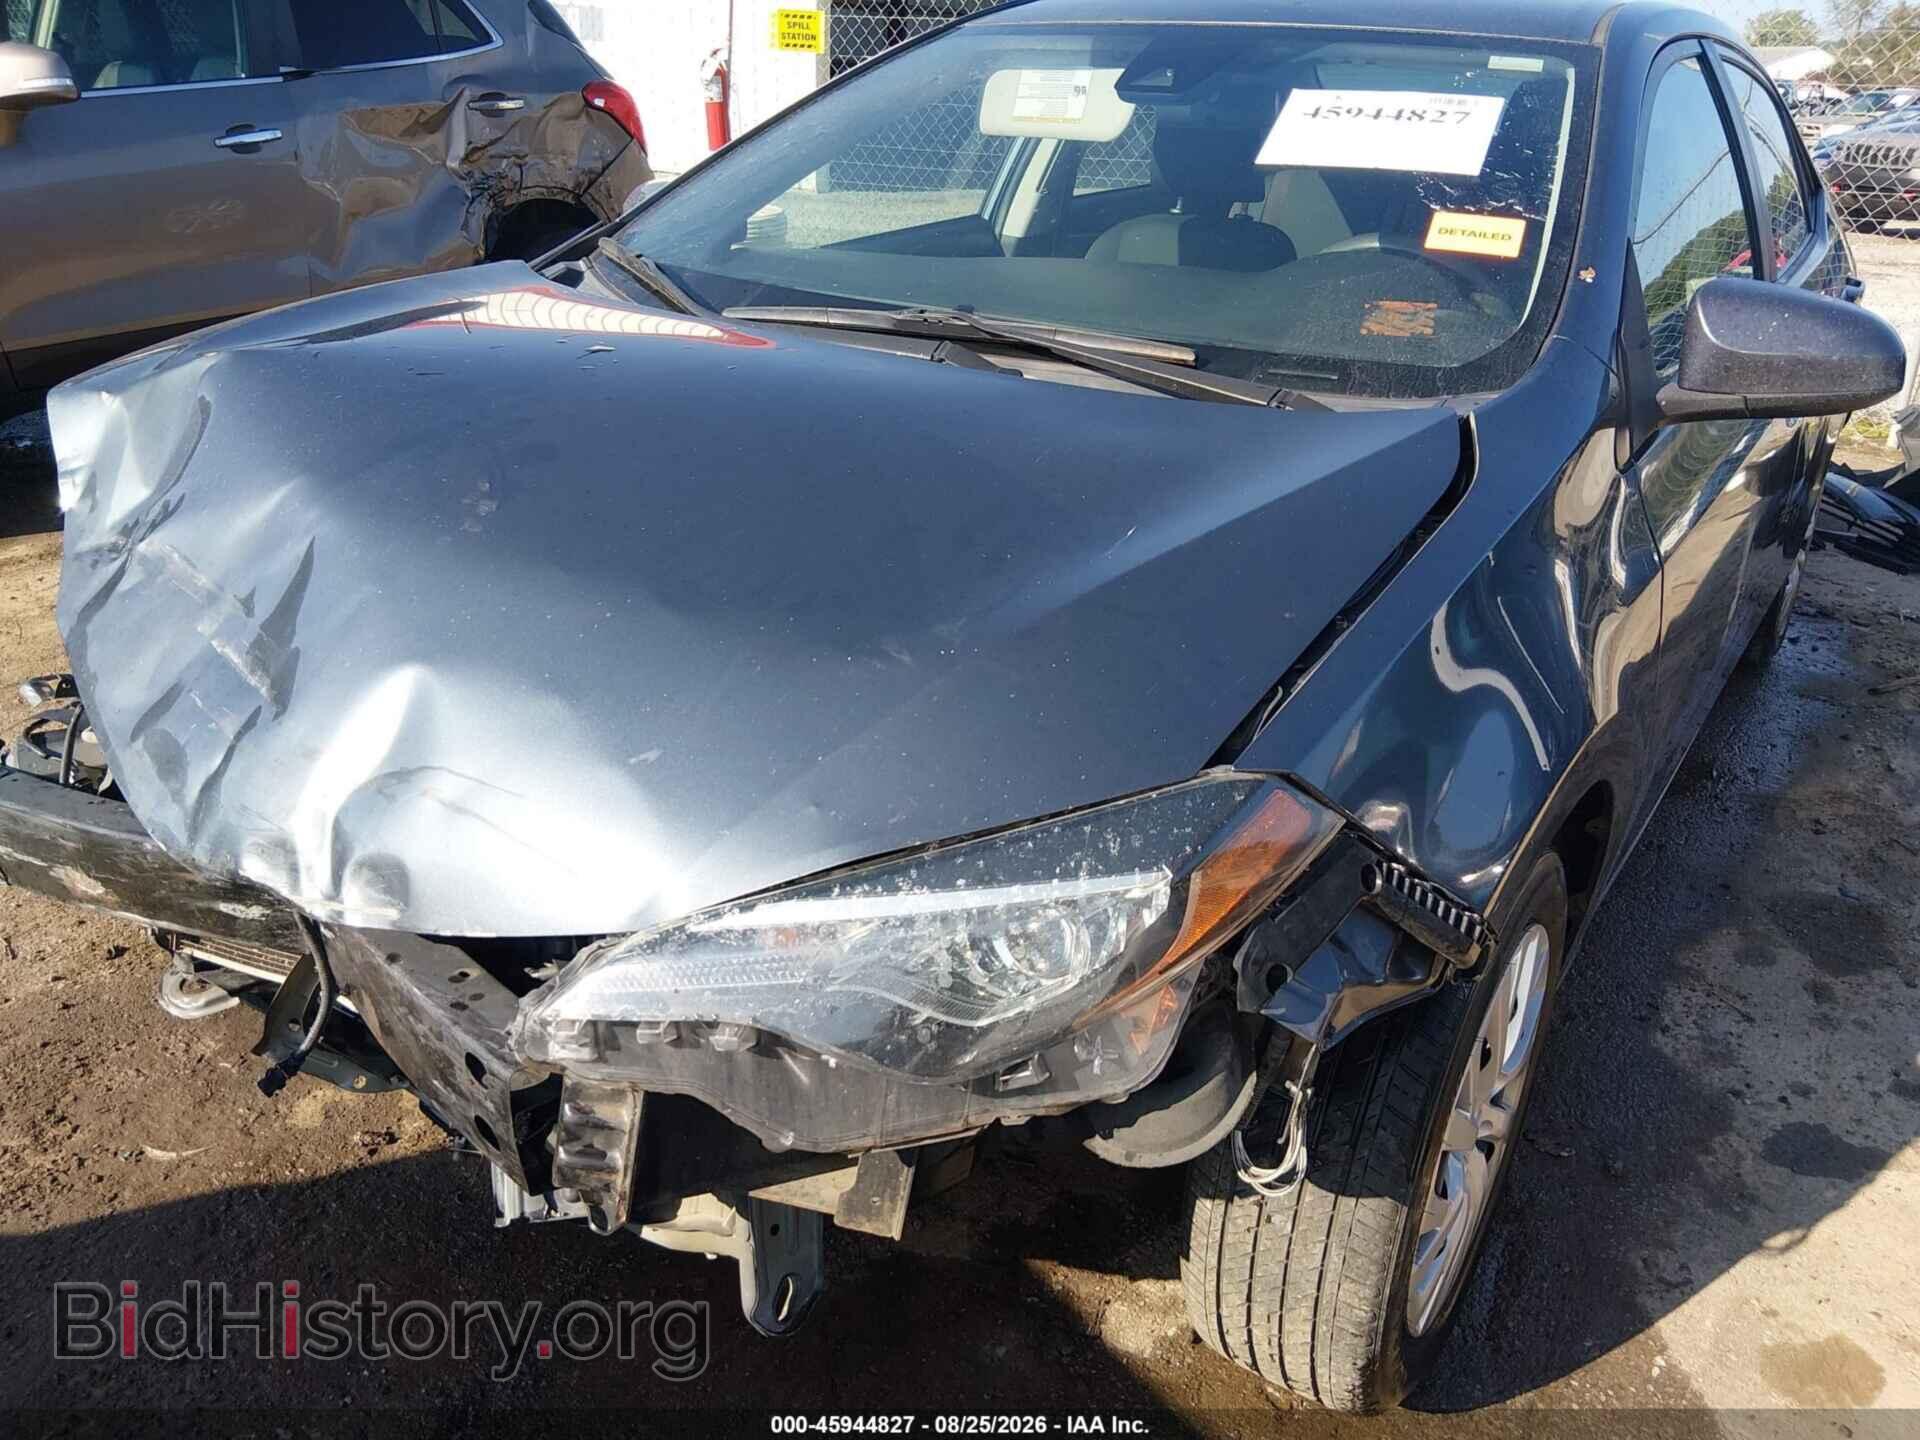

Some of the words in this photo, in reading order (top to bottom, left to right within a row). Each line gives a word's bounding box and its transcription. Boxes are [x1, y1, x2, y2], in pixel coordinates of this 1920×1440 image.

[786, 21, 810, 30] SPILL
[781, 32, 817, 41] STATION
[1303, 104, 1472, 124] 45944827
[1437, 226, 1513, 241] DETAILED
